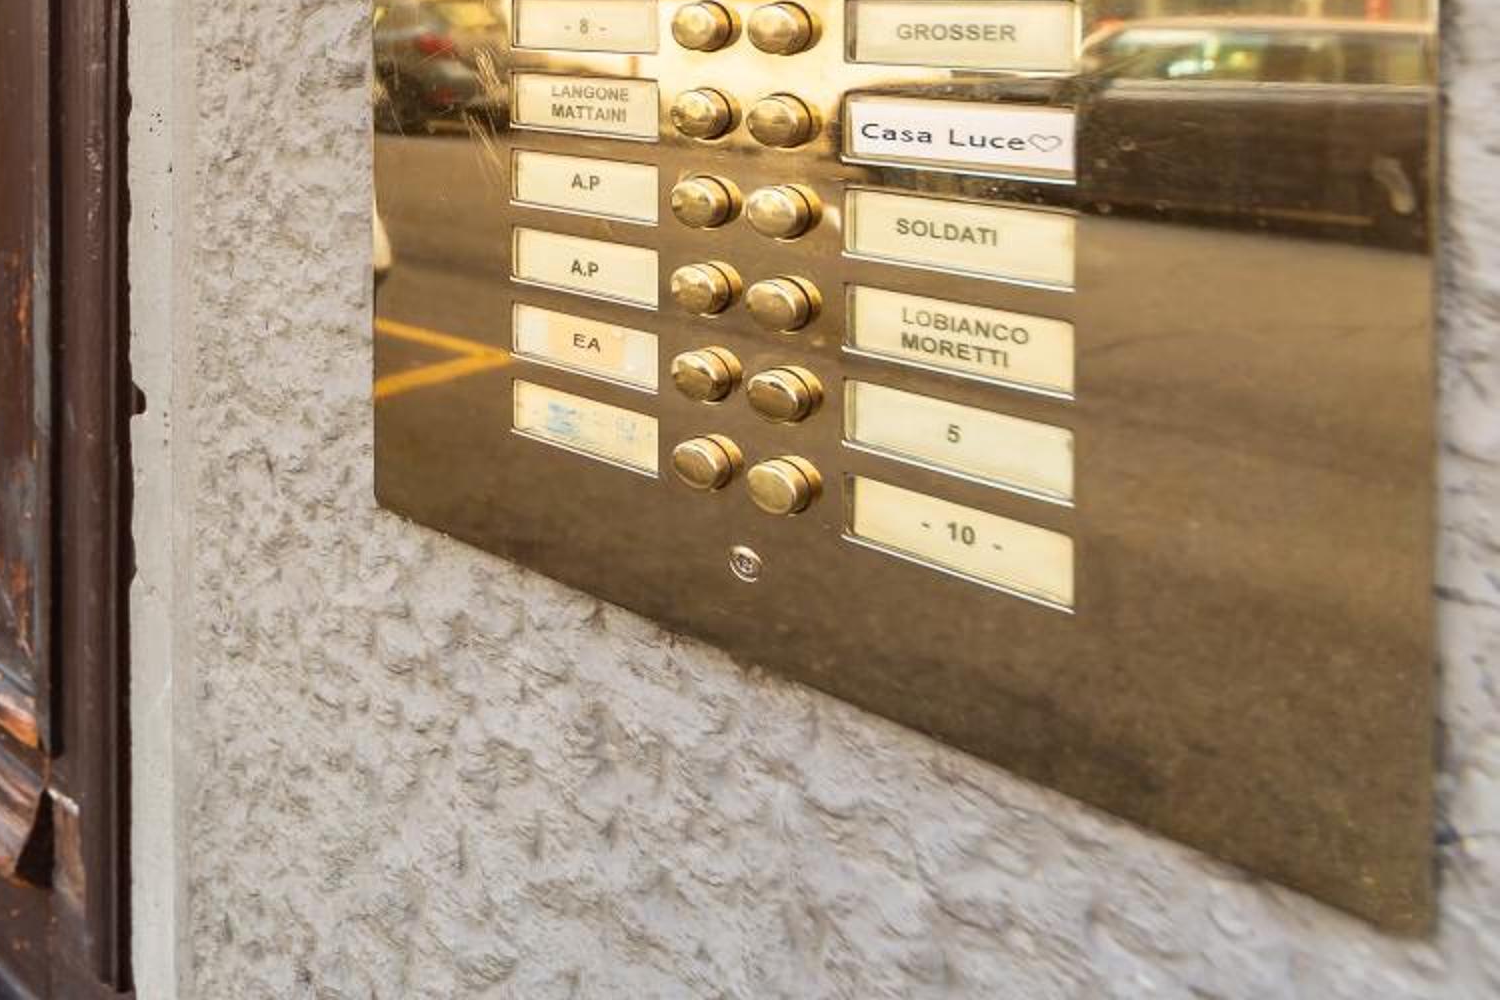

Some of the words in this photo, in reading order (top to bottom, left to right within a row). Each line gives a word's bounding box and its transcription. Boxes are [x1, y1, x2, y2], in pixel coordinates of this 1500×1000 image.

[896, 24, 1017, 41] GROSSER
[551, 84, 629, 102] LANGONE
[551, 104, 627, 123] MATTAINI
[860, 123, 933, 143] Casa
[896, 218, 998, 246] SOLDATI
[902, 307, 1030, 345] LOBIANCO
[901, 333, 1010, 368] MORETTI
[947, 424, 961, 443] 5
[947, 522, 975, 545] 10
